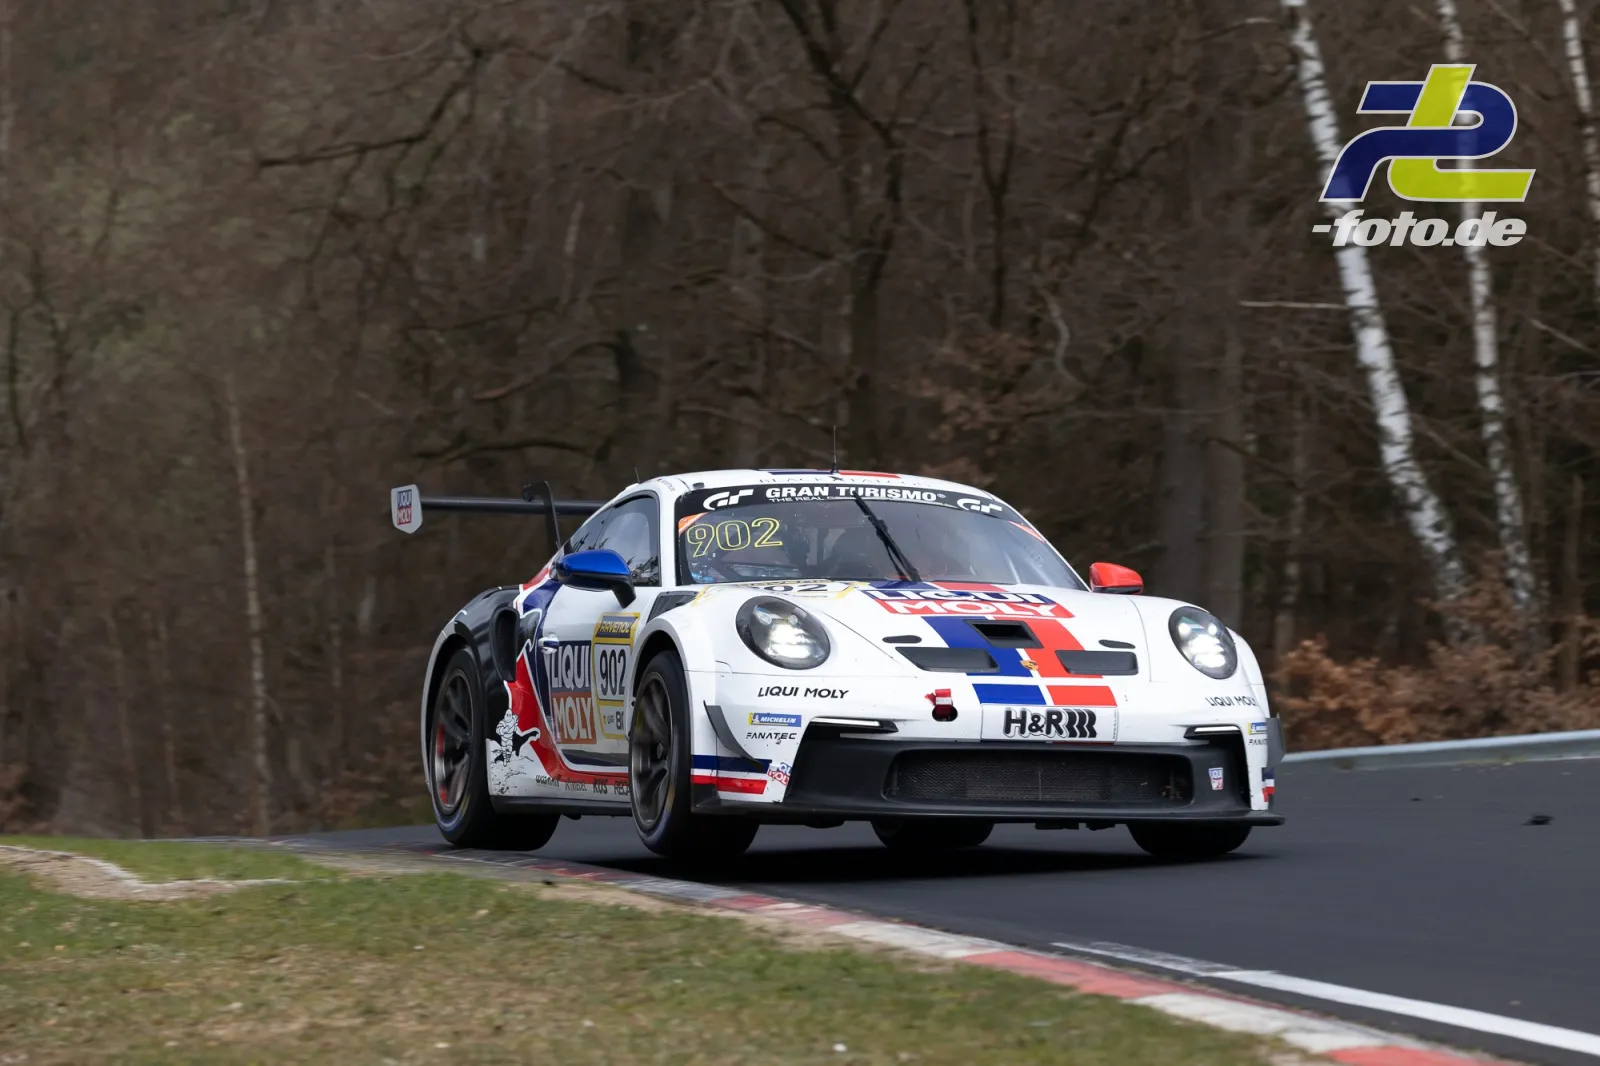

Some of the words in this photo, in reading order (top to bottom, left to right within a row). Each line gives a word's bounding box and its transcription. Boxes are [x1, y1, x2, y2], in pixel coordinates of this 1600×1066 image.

[766, 486, 829, 498] GRAN
[686, 517, 783, 558] 902
[885, 600, 1056, 616] MOLY
[600, 621, 631, 633] RAVENOL
[551, 644, 590, 691] LIQUI
[600, 648, 627, 696] 902
[757, 686, 799, 698] LIQUI
[803, 687, 849, 699] MOLY
[1204, 695, 1235, 706] LIQUI
[553, 696, 593, 739] MOLY
[760, 716, 797, 724] MICHELIN
[746, 732, 798, 740] FANATEC
